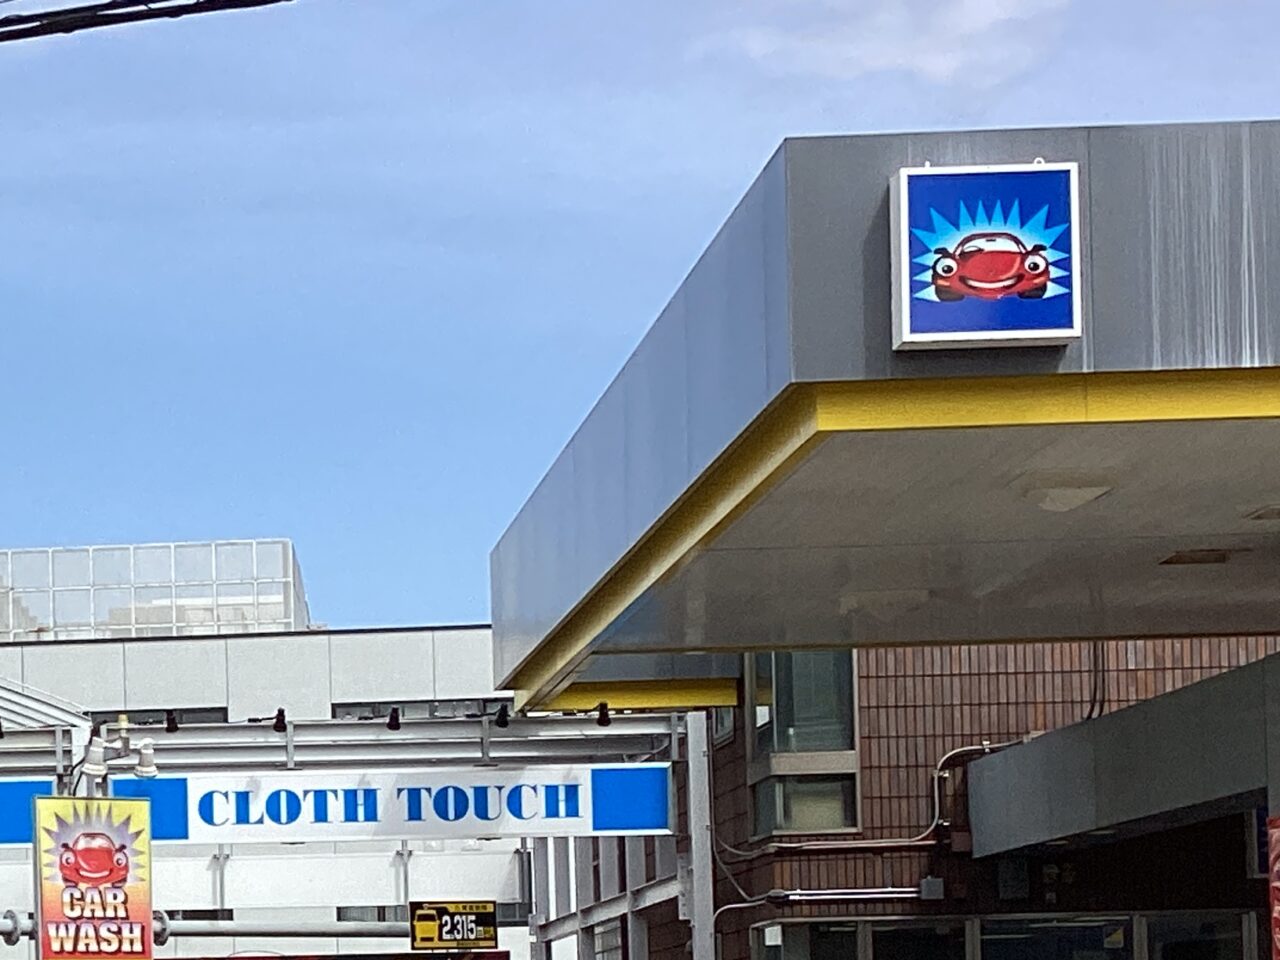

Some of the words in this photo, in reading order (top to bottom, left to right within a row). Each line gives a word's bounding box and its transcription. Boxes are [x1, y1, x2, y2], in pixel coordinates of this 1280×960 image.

[198, 787, 378, 826] CLOTH
[396, 784, 582, 822] TOUCH
[61, 886, 128, 919] CAR
[47, 920, 143, 953] WASH
